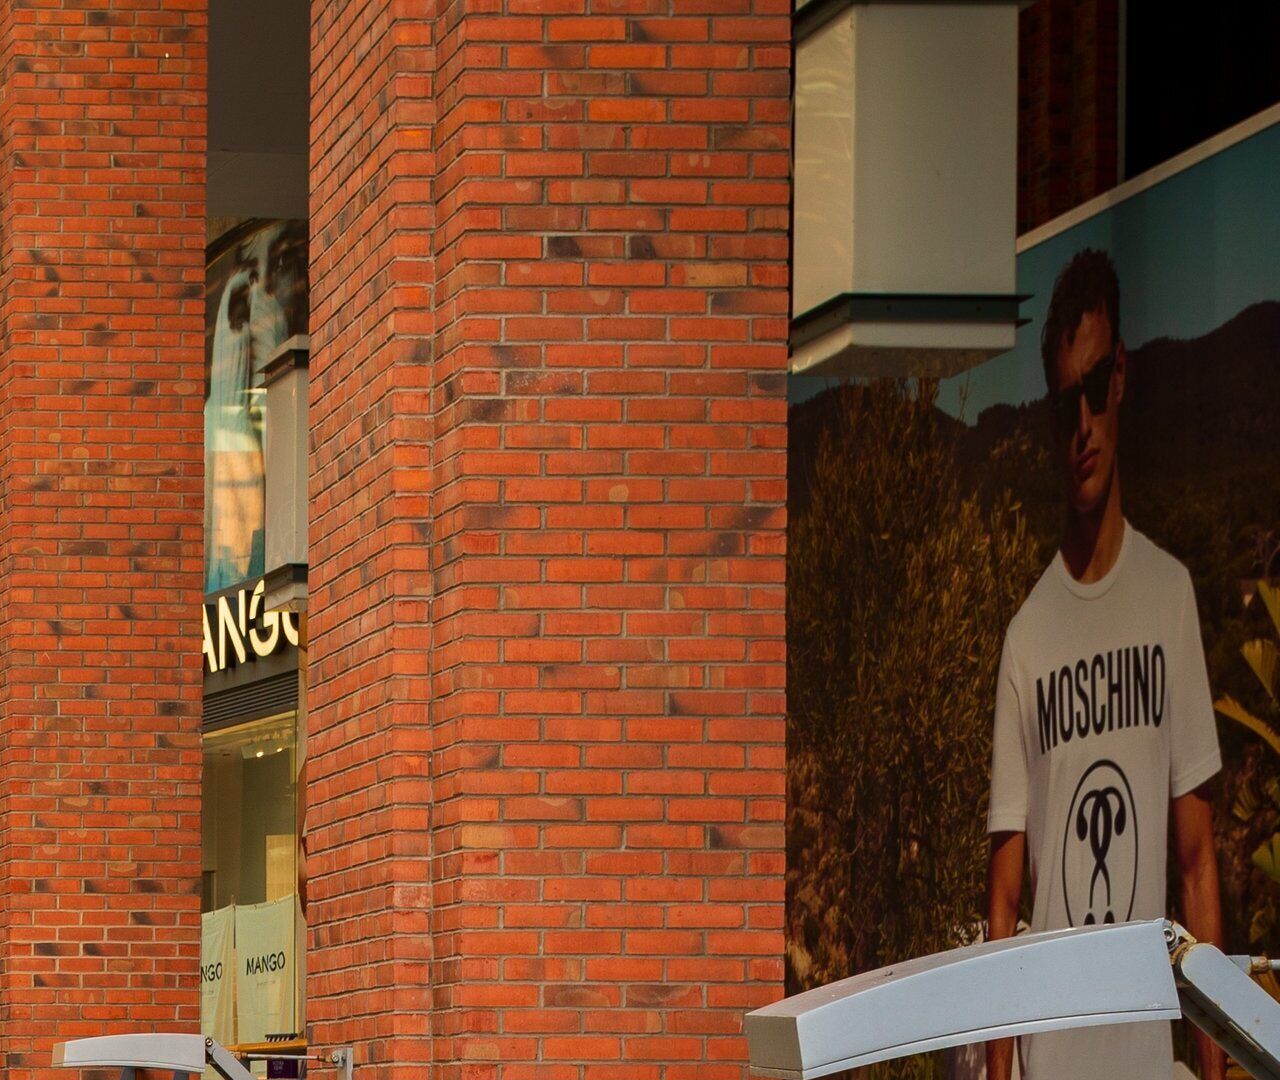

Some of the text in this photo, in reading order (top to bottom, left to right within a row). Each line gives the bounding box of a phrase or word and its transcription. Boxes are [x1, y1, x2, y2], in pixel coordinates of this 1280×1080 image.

[201, 579, 299, 673] ANG
[1035, 643, 1166, 756] MOSCHINO
[246, 951, 286, 976] MANGO
